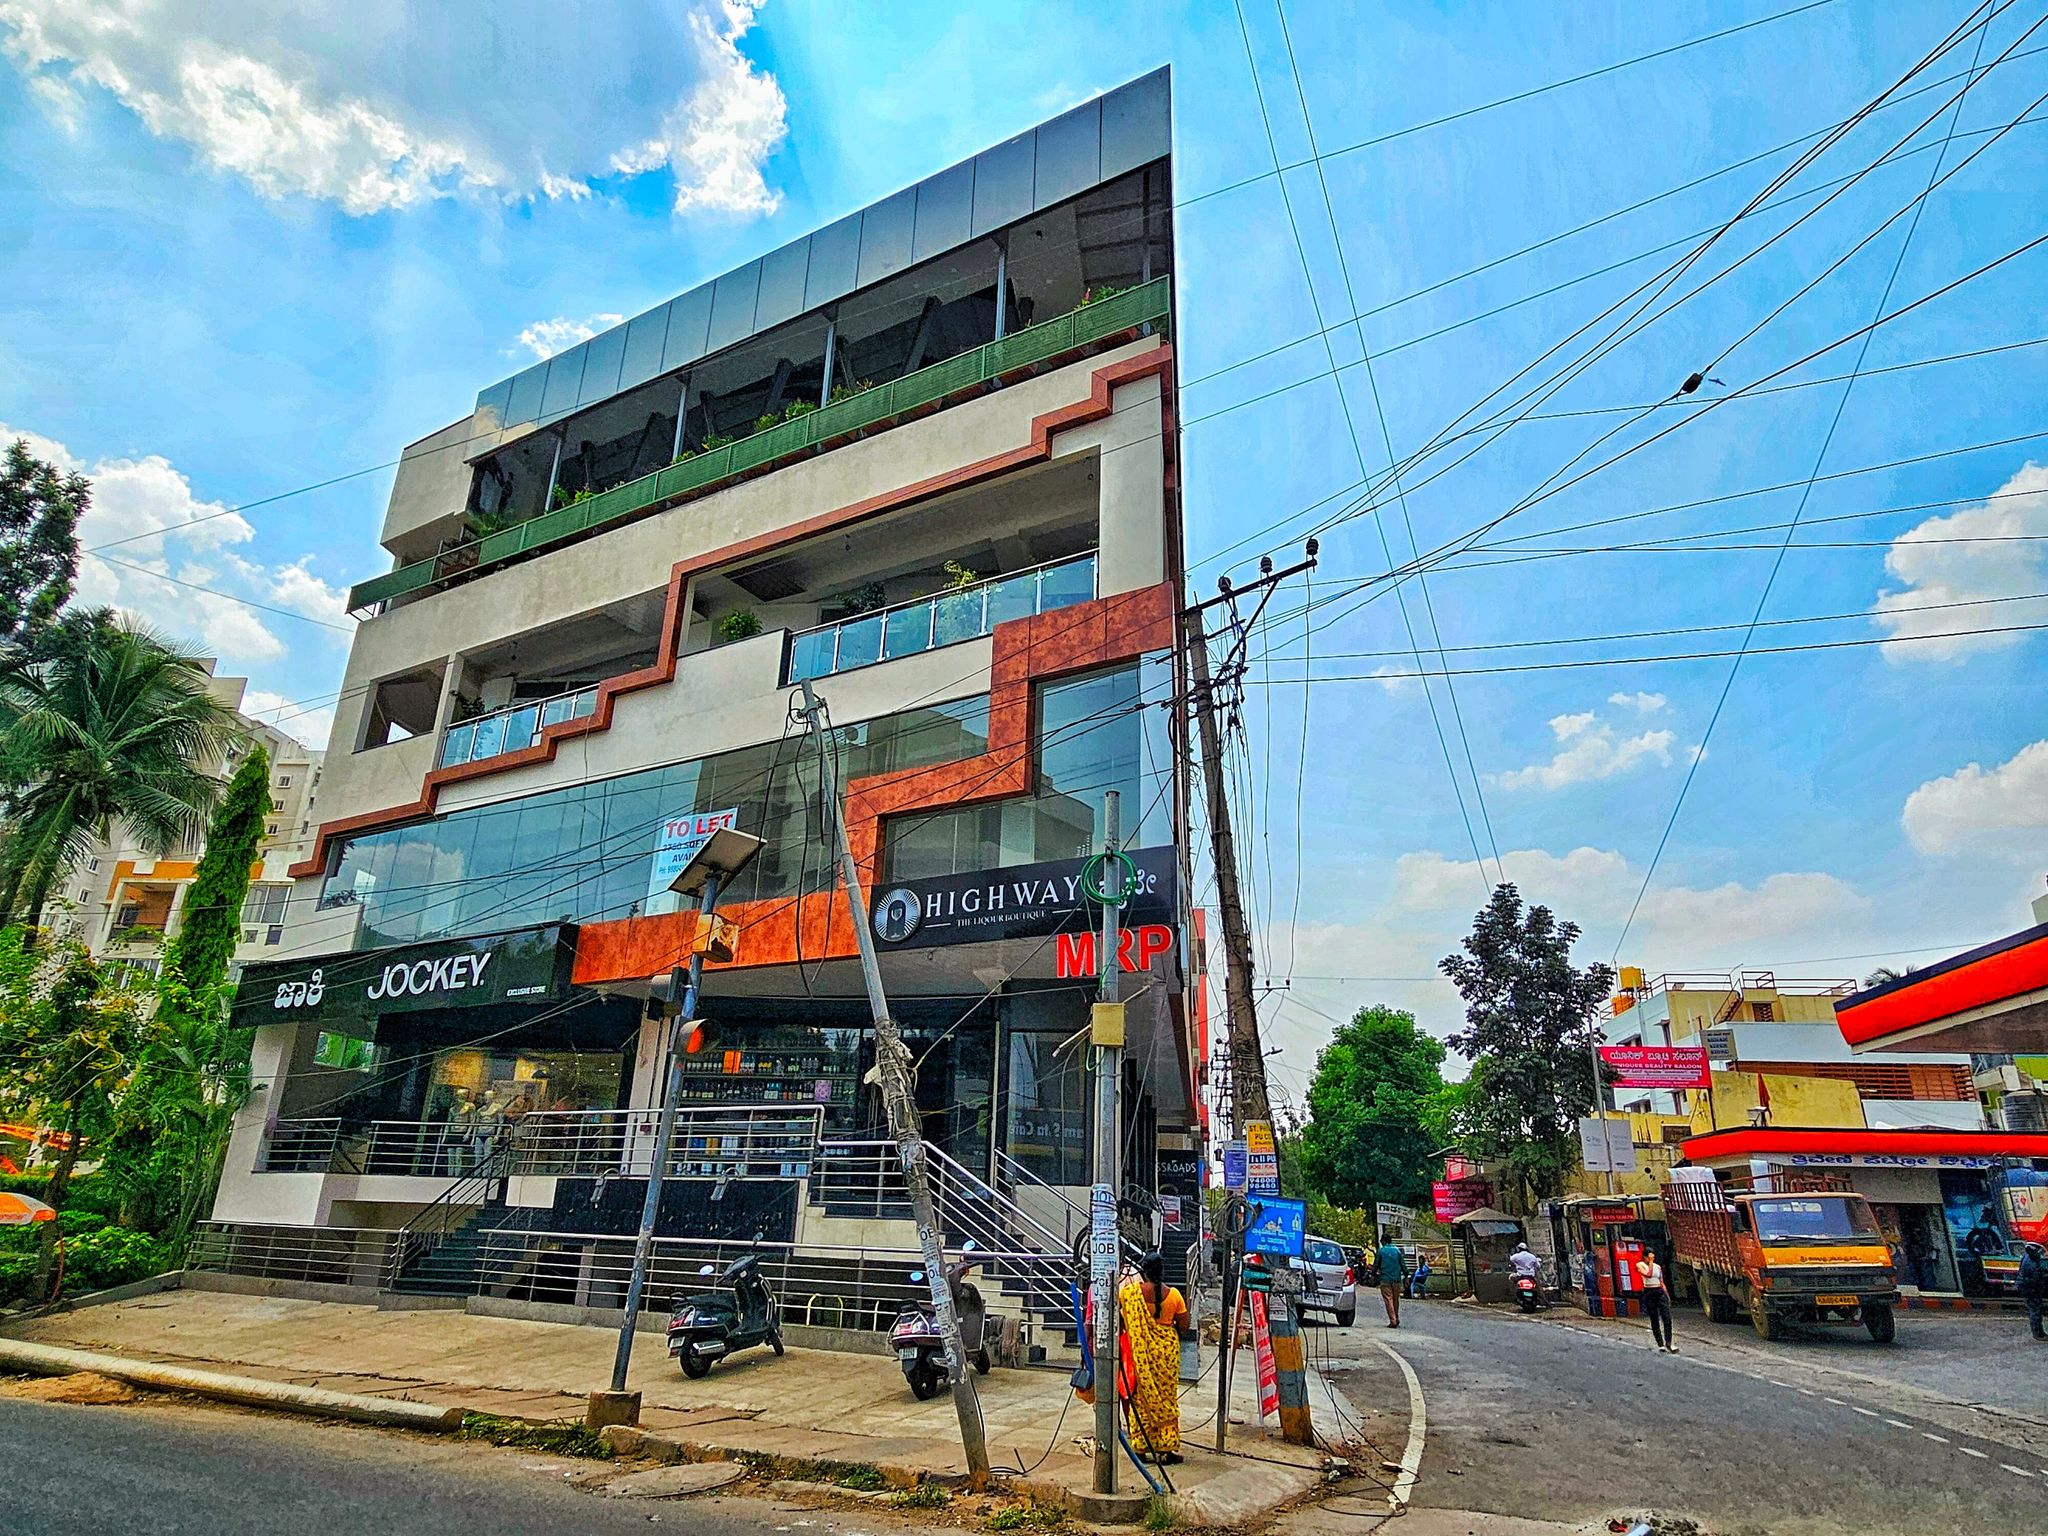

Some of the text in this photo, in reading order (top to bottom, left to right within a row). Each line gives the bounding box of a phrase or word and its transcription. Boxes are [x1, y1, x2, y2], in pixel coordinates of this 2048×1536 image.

[665, 813, 734, 839] TO LET
[957, 918, 971, 927] THE
[1005, 909, 1047, 922] BOUTIQUE
[1056, 924, 1174, 978] MRP
[274, 968, 326, 1009] ಜಾಕಿ
[531, 985, 547, 994] STORE
[1092, 1243, 1116, 1255] JOB
